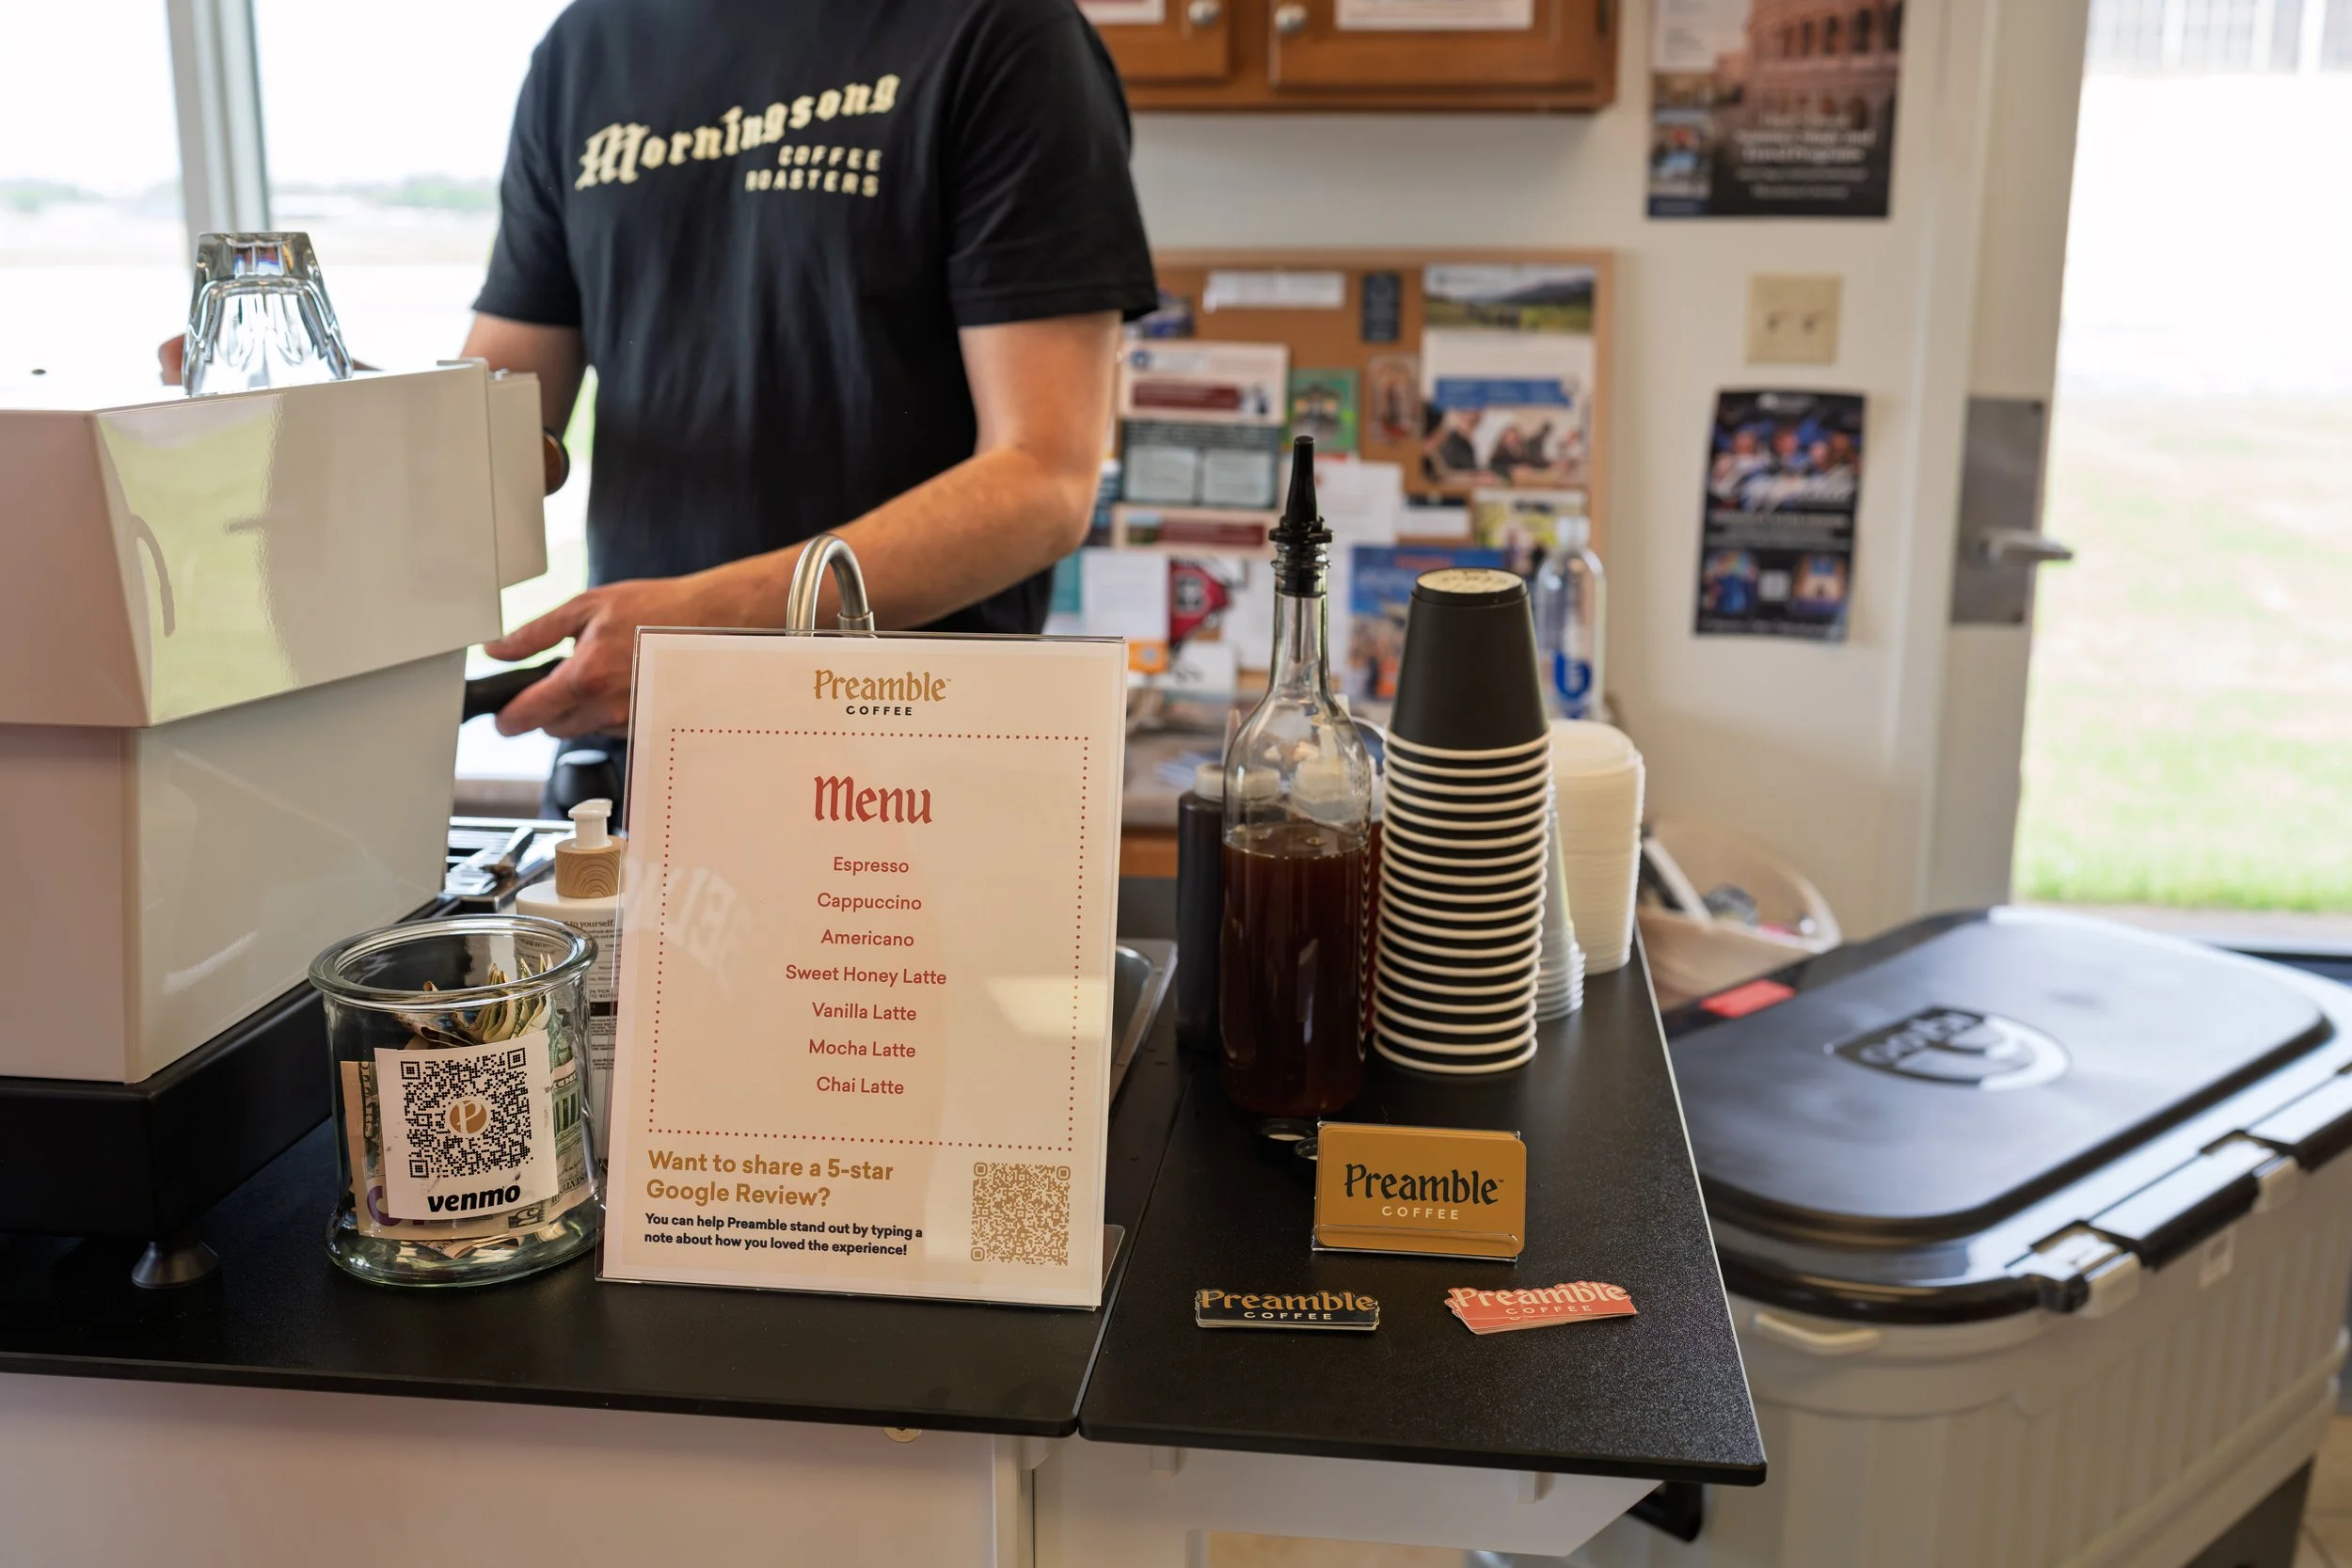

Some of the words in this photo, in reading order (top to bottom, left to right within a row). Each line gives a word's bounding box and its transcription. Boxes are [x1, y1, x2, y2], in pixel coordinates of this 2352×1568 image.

[575, 73, 900, 192] Morningsong
[778, 145, 882, 172] COFFEE
[745, 168, 880, 198] ROASTERS
[846, 705, 913, 716] COFFEE
[814, 775, 933, 825] Menu
[834, 856, 910, 876] Espresso
[817, 892, 922, 913] Cappuccino
[820, 928, 914, 947] Americano
[786, 964, 840, 981] Sweet
[844, 966, 898, 988] Honey
[902, 969, 947, 985] Latte
[811, 1002, 868, 1020] Vanilla
[873, 1005, 917, 1022] Latte
[808, 1038, 867, 1056] Mocha
[872, 1041, 916, 1058] Latte
[816, 1076, 856, 1093] Chai
[860, 1078, 904, 1095] Latte
[648, 1149, 708, 1172] Want
[712, 1154, 737, 1174] to
[741, 1154, 803, 1177] share
[809, 1163, 822, 1177] a
[827, 1158, 894, 1180] 5-star
[427, 1185, 521, 1213] venmo
[646, 1179, 730, 1207] Google
[736, 1182, 831, 1207] Review?
[1381, 1206, 1459, 1220] COFFEE
[645, 1212, 669, 1225] You
[672, 1216, 694, 1227] can
[696, 1215, 724, 1230] help
[727, 1216, 787, 1230] Preamble
[789, 1221, 825, 1233] stand
[828, 1224, 850, 1234] out
[852, 1223, 868, 1238] by
[871, 1225, 913, 1241] typing
[915, 1229, 923, 1238] a
[644, 1232, 673, 1243] note
[675, 1233, 712, 1246] about
[715, 1234, 741, 1247] how
[744, 1239, 767, 1251] you
[771, 1238, 805, 1250] loved
[808, 1240, 829, 1252] the
[832, 1242, 907, 1256] experience!
[1200, 1290, 1378, 1312] Preamble
[1454, 1282, 1629, 1308] Preamble
[1244, 1311, 1332, 1321] COFFEE
[1505, 1305, 1592, 1315] COFFEE
